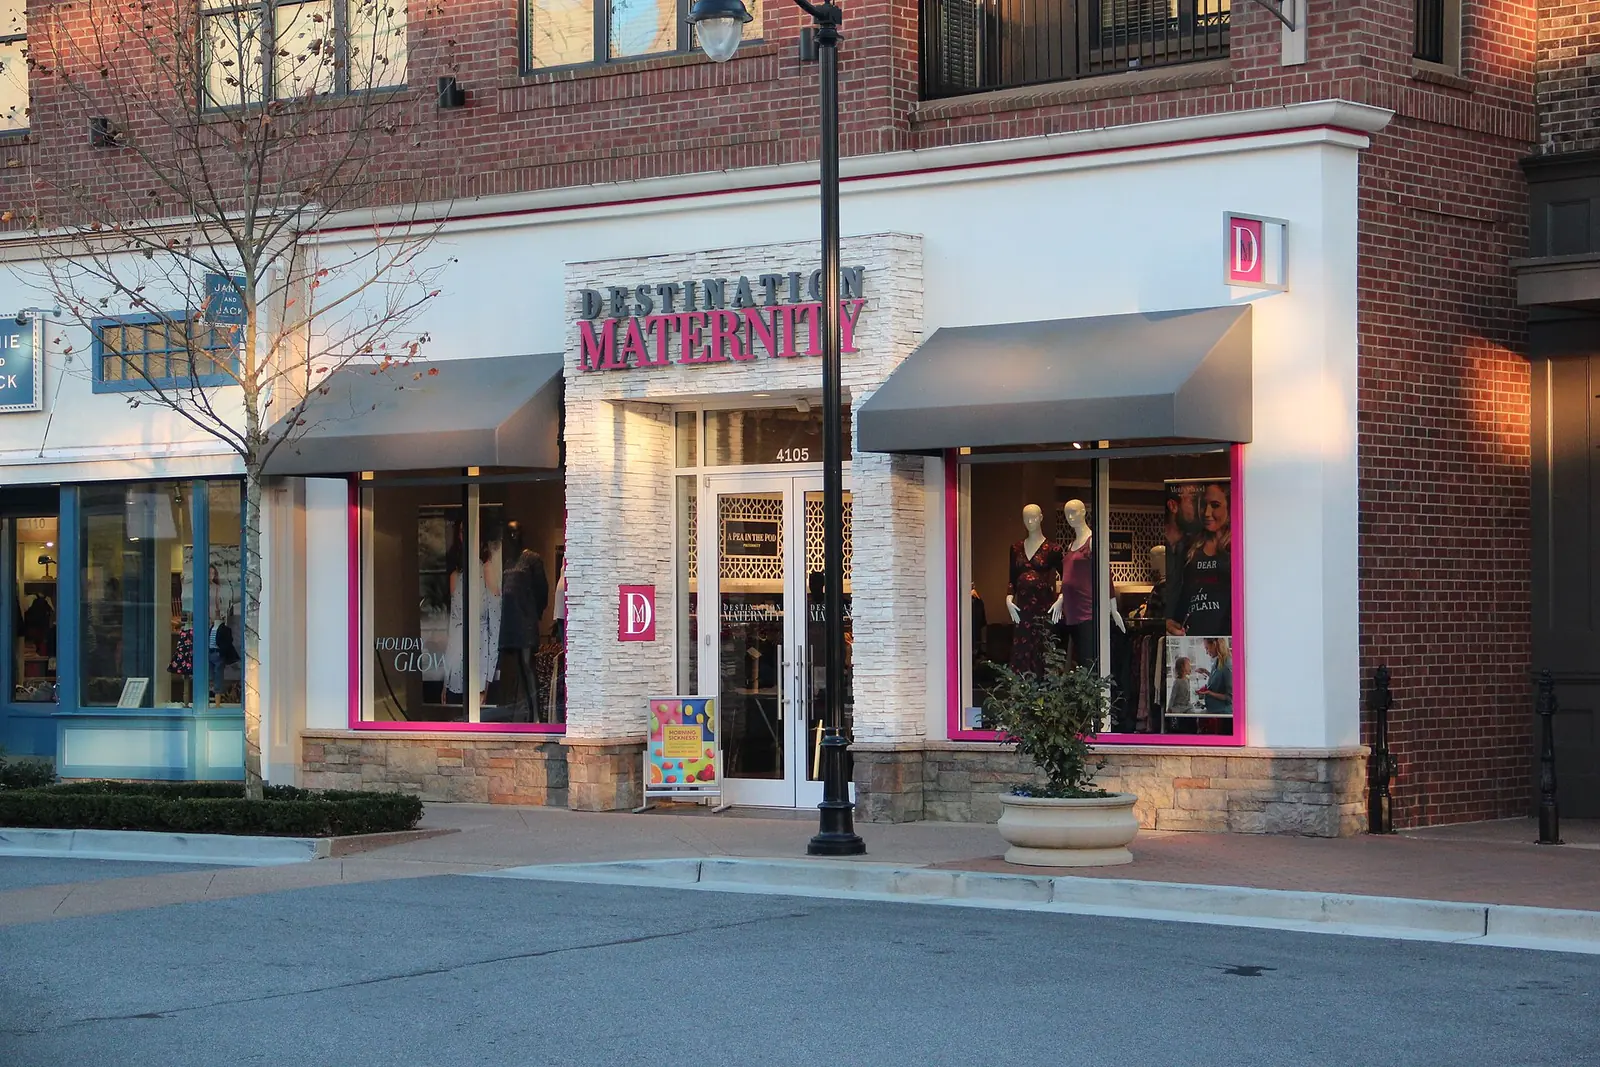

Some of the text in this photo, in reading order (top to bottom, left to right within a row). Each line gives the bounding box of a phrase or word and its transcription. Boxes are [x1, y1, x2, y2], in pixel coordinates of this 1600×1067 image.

[580, 265, 866, 320] DESTINATION
[576, 298, 867, 371] MATERNITY
[776, 447, 810, 463] 4105
[732, 532, 744, 541] PEA
[752, 534, 764, 542] THE
[765, 534, 777, 542] POD
[1196, 560, 1217, 570] DEAR
[376, 637, 425, 650] HOLIDAY
